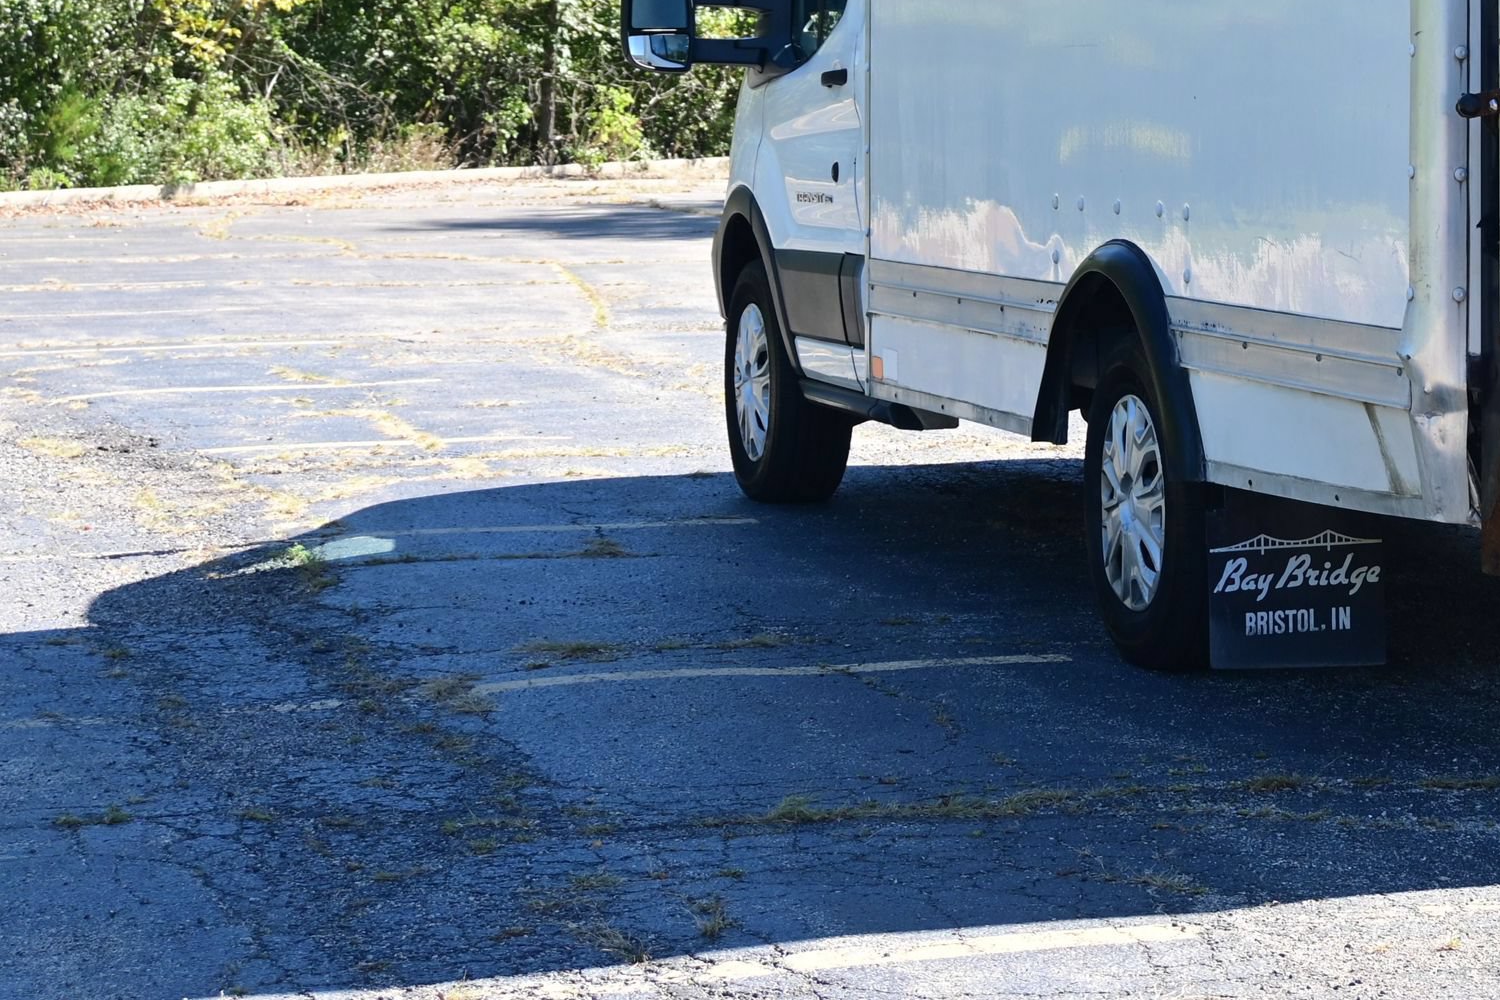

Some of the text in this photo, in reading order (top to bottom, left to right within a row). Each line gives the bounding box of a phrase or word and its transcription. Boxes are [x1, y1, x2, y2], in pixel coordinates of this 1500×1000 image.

[1213, 552, 1382, 602] Bay Bridge
[1245, 606, 1351, 636] BRISTOL, IN
